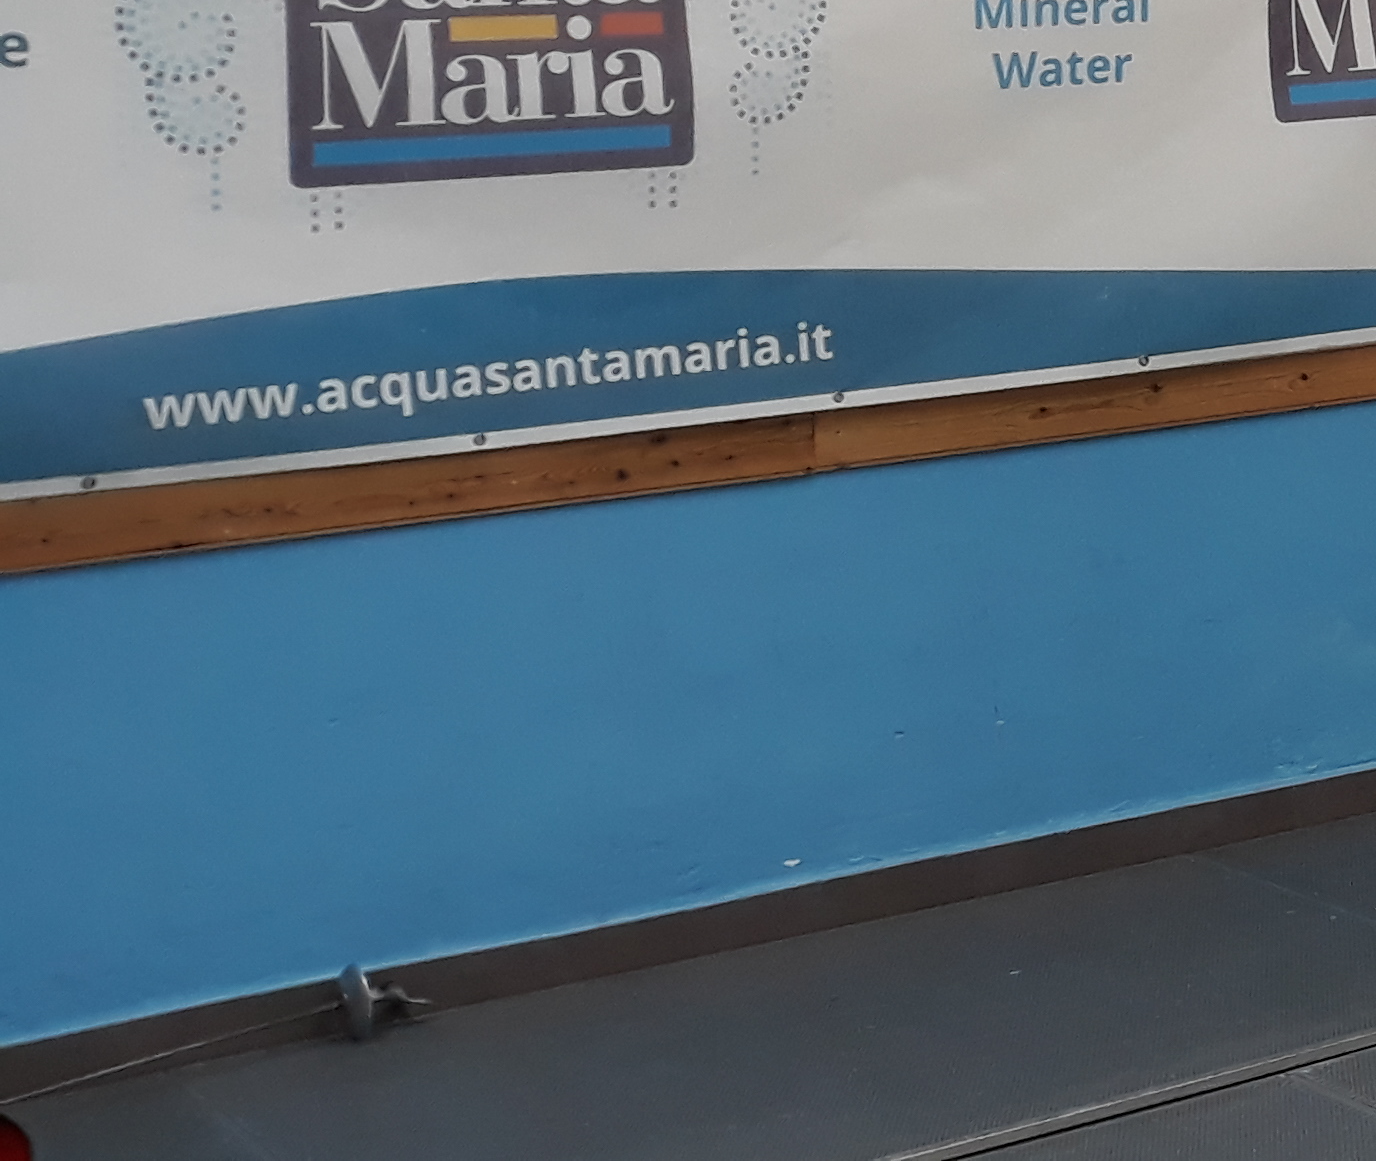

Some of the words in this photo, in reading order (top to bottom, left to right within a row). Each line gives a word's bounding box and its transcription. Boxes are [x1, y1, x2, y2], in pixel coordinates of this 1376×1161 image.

[310, 15, 675, 131] Maria
[993, 50, 1134, 90] Water
[143, 322, 835, 431] www.acquasantamaria.it
